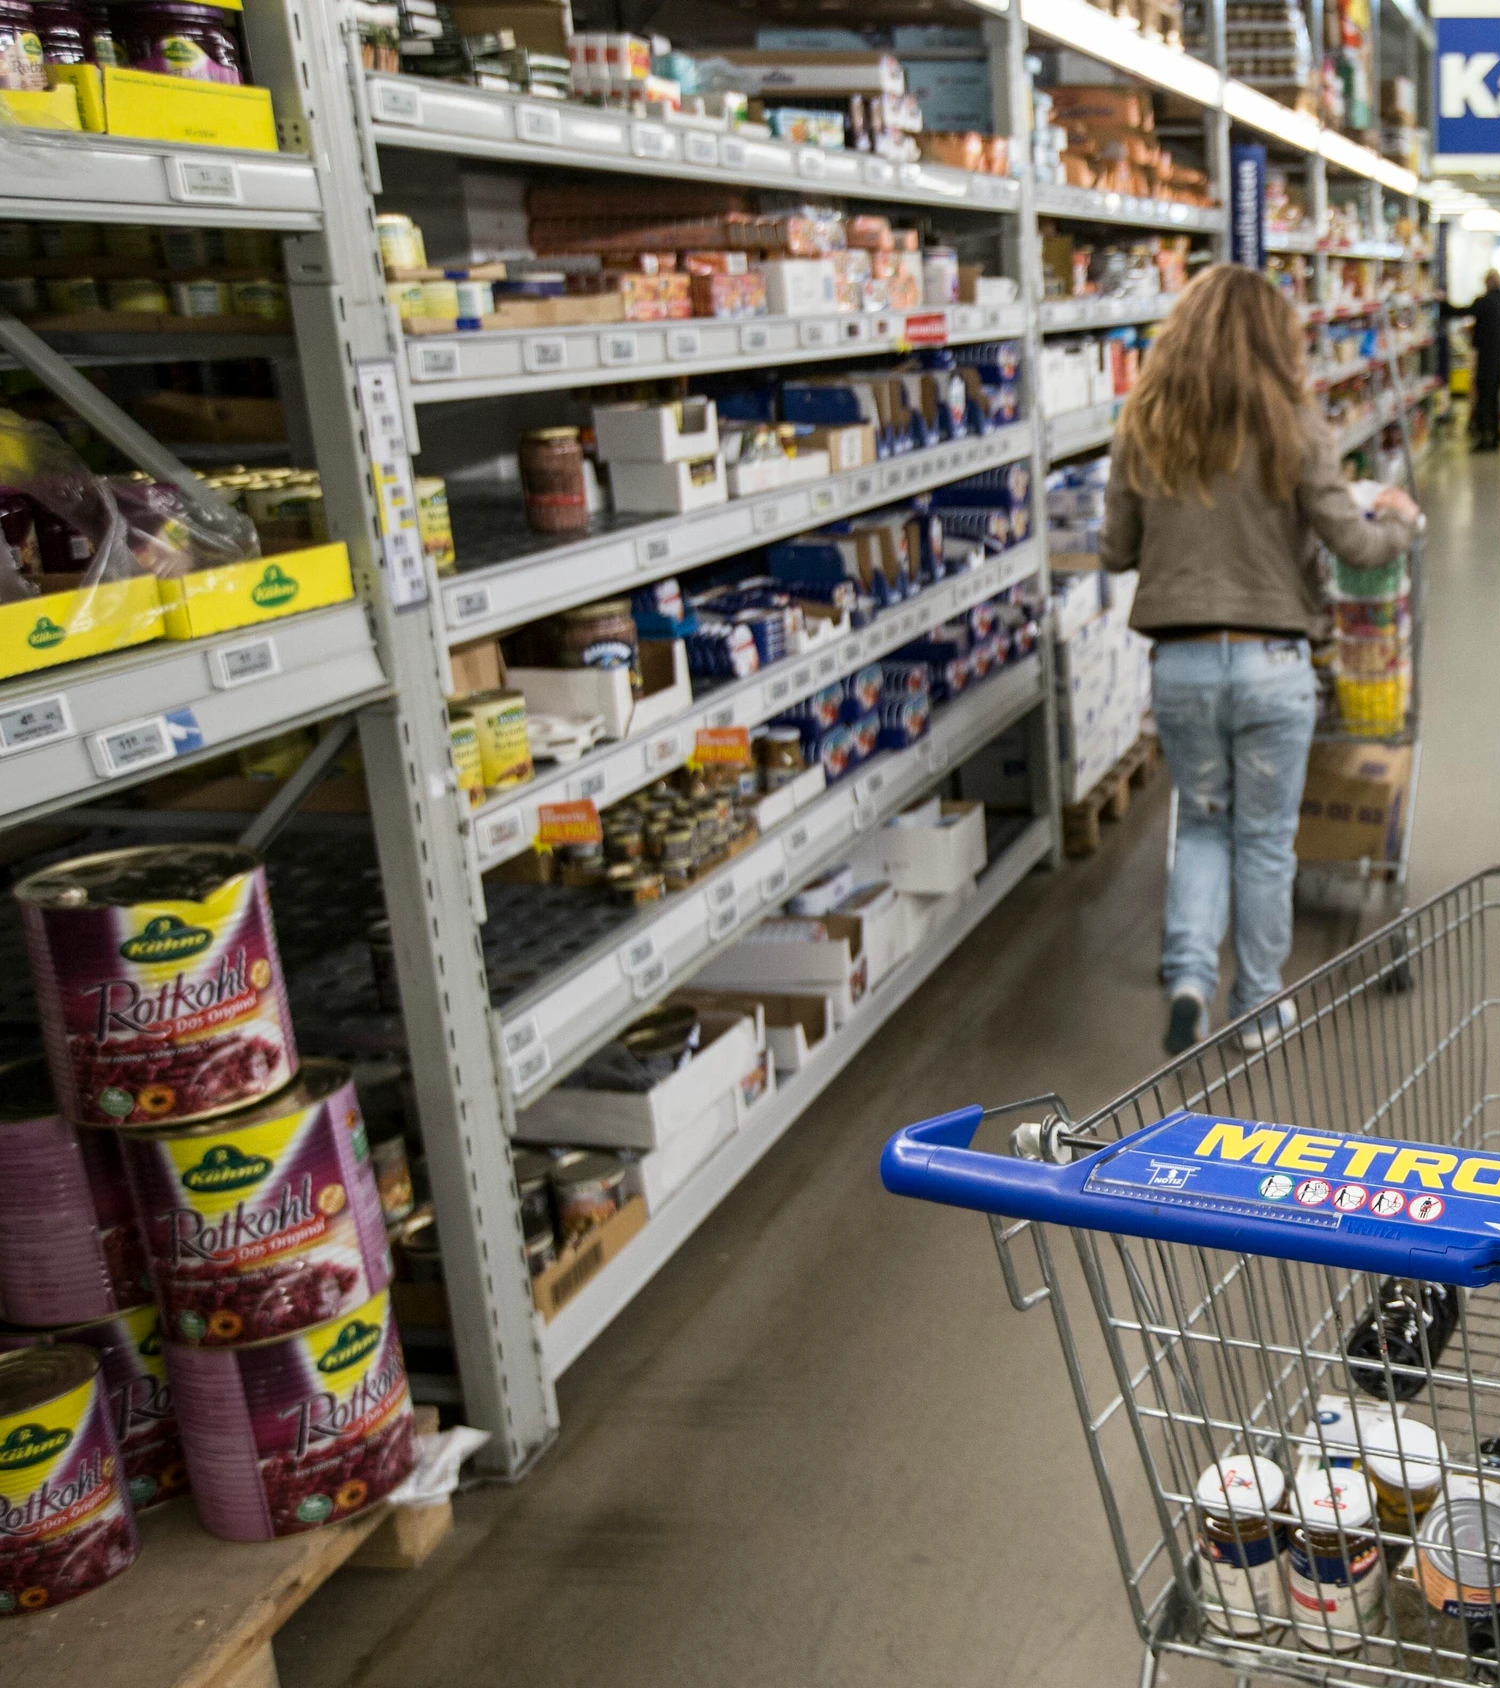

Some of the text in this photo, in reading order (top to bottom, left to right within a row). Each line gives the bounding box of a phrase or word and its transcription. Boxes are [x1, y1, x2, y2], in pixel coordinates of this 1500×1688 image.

[129, 932, 208, 957] Kühne
[82, 946, 247, 1046] Rotkohl
[175, 996, 258, 1032] Das Original
[191, 1162, 266, 1186] Kühne
[1154, 1177, 1183, 1185] NOTIZ
[158, 1172, 313, 1269] Rotkohl
[239, 1218, 326, 1259] Das Original
[325, 1330, 380, 1370] Kühne
[279, 1358, 400, 1462] Rotkoh
[42, 1516, 69, 1530] Das
